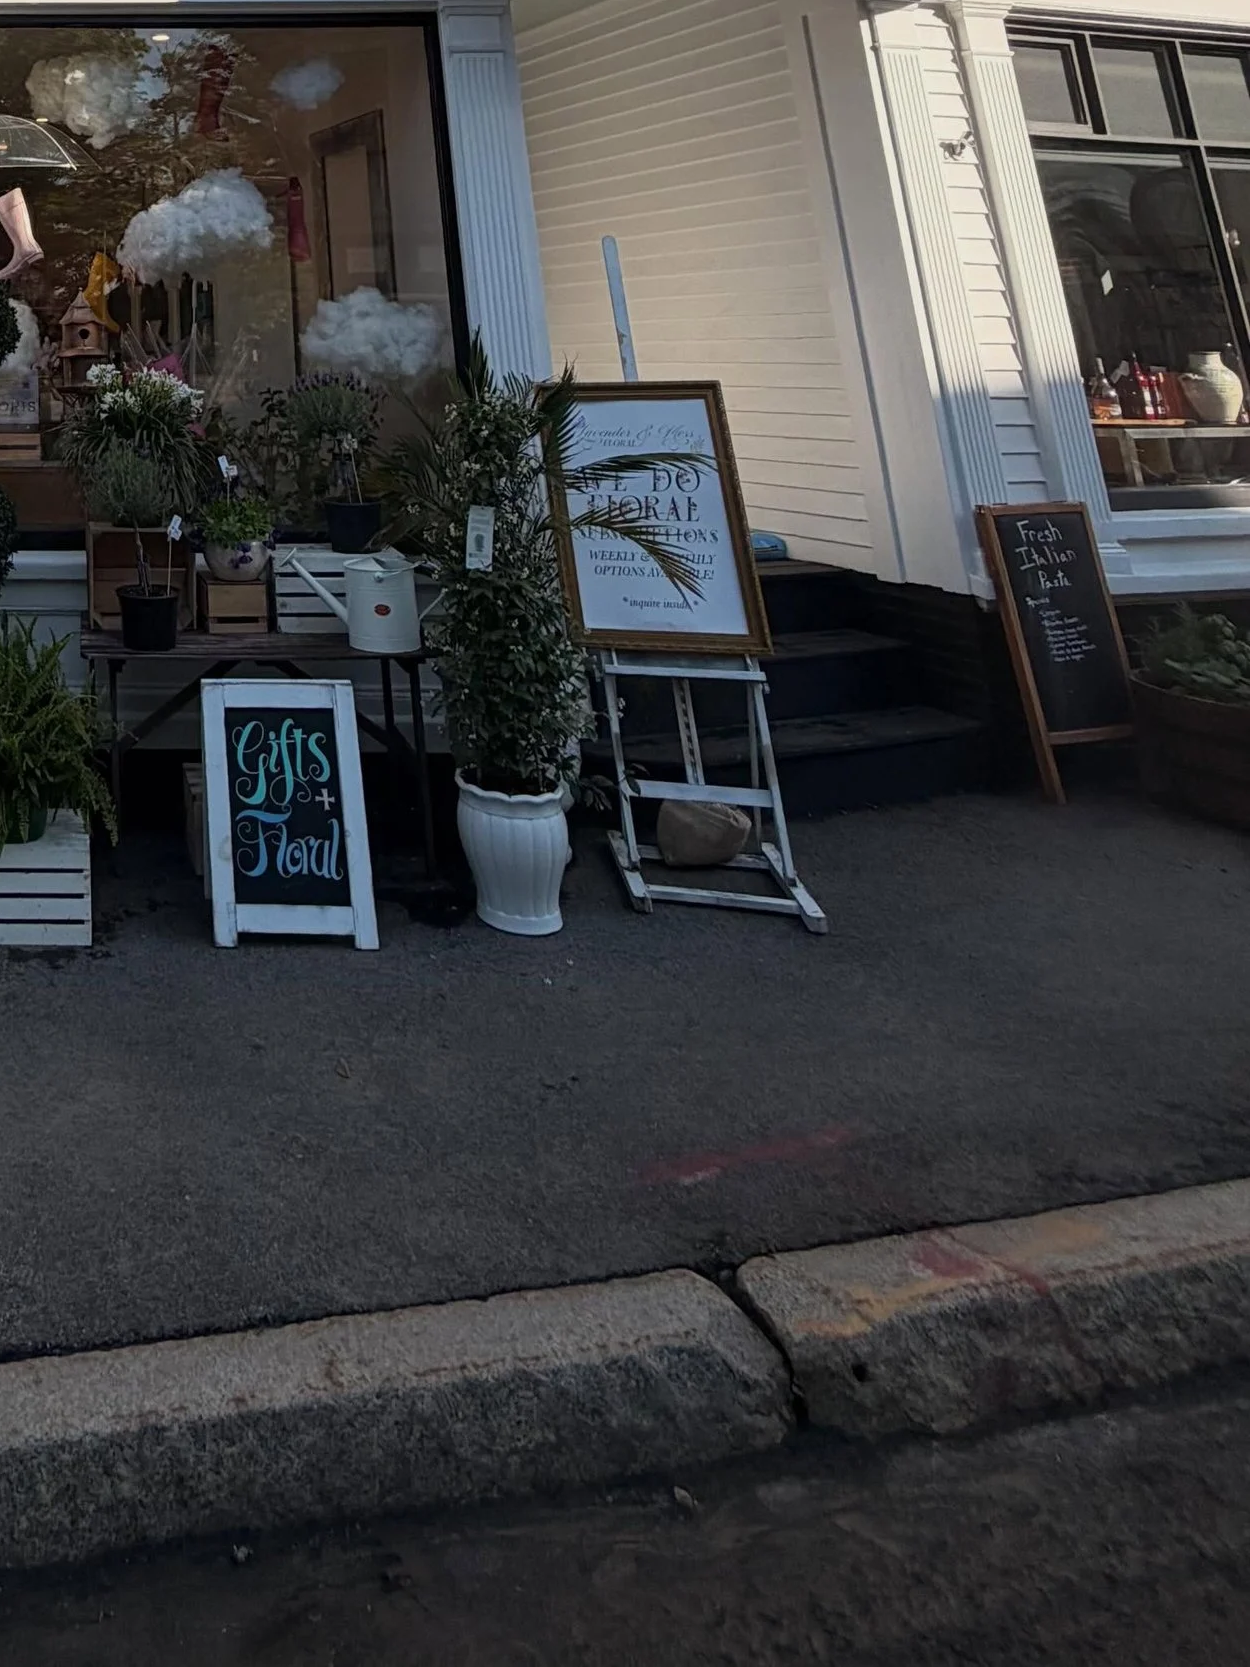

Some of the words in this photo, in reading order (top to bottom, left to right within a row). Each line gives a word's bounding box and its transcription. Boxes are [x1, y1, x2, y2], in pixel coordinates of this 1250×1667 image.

[652, 467, 700, 493] DO
[587, 494, 700, 523] FLORAL
[573, 525, 719, 544] SUBSCIPTIONS
[1016, 519, 1063, 543] Fresh
[589, 549, 638, 562] WEEKLY
[640, 551, 651, 562] &
[651, 552, 716, 565] THLY
[1015, 545, 1077, 570] Italian
[594, 565, 645, 577] OPTIONS
[232, 718, 331, 805] Gifts
[236, 804, 344, 881] Floral
